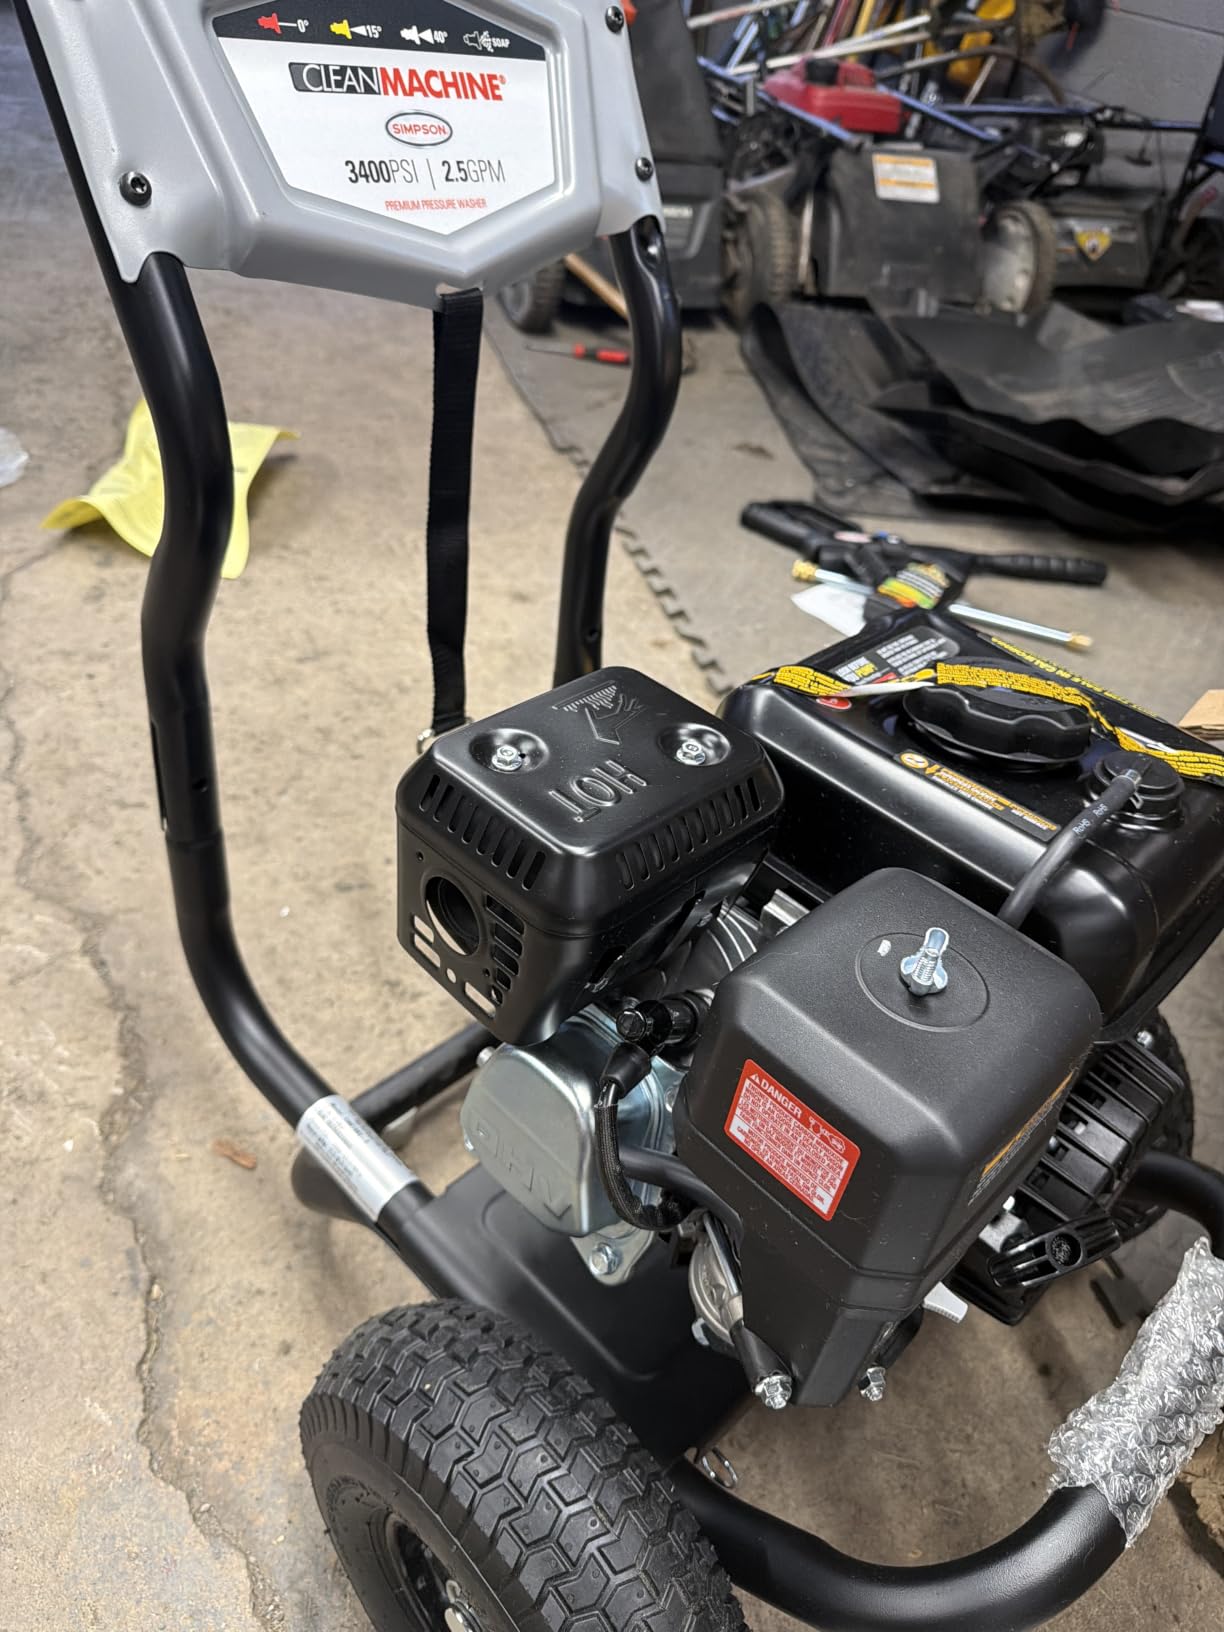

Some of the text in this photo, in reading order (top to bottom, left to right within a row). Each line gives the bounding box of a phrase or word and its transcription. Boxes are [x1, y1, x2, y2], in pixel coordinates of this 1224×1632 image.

[392, 123, 448, 135] SIMPSON
[345, 158, 506, 184] 3400PSI 2.5GPM
[384, 198, 488, 212] PREMIUM PRESSURE WASHER
[548, 759, 648, 823] HOT
[1072, 818, 1091, 836] RoHS
[759, 1077, 803, 1119] DANGER
[742, 1091, 751, 1101] DO
[750, 1098, 761, 1110] NOT
[760, 1106, 783, 1129] OPERATE
[789, 1131, 799, 1142] AN
[798, 1138, 826, 1165] ENCLOSED
[766, 1105, 775, 1115] AN
[801, 1134, 822, 1155] DEADLY
[768, 1099, 793, 1123] PRODUCE
[792, 1120, 815, 1141] CARBON
